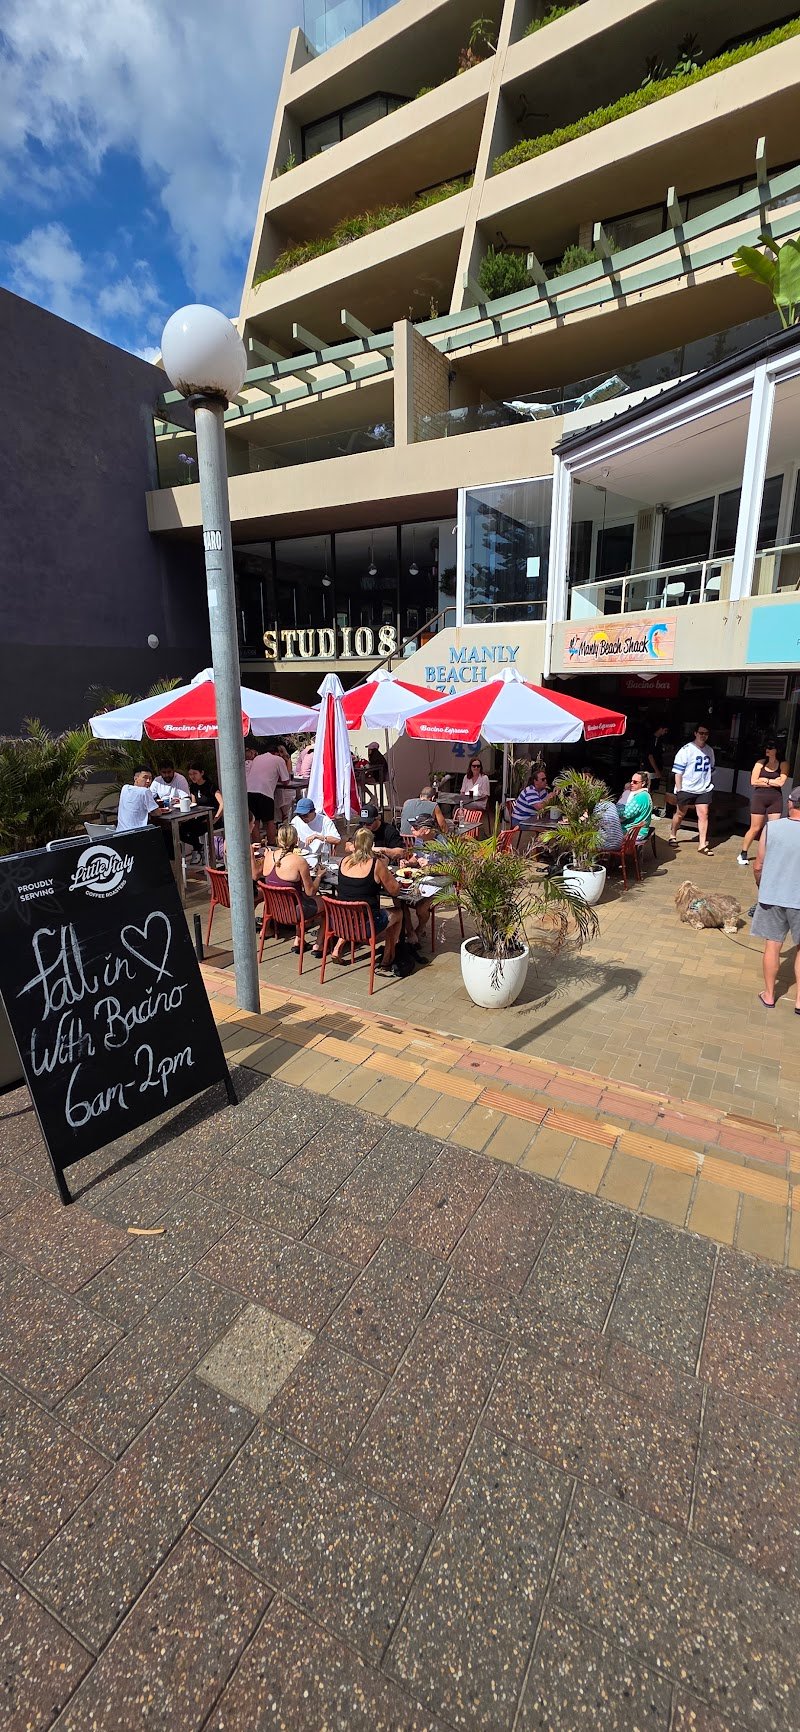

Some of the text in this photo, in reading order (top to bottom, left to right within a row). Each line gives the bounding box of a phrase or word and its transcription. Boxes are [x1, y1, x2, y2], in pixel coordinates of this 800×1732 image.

[449, 645, 520, 663] MANLY
[579, 636, 649, 658] Manly Beach Shack
[424, 666, 488, 682] BEACH
[625, 678, 671, 690] Bacino bar
[163, 724, 197, 732] Bacino
[420, 724, 444, 733] Bacino
[694, 755, 711, 773] 22
[69, 853, 135, 892] Little Italy
[17, 878, 55, 894] PROUDLY
[20, 887, 55, 902] SERVING
[85, 879, 127, 899] COFFEE ROASTERS
[104, 953, 136, 987] in
[93, 983, 189, 1051] Bacino
